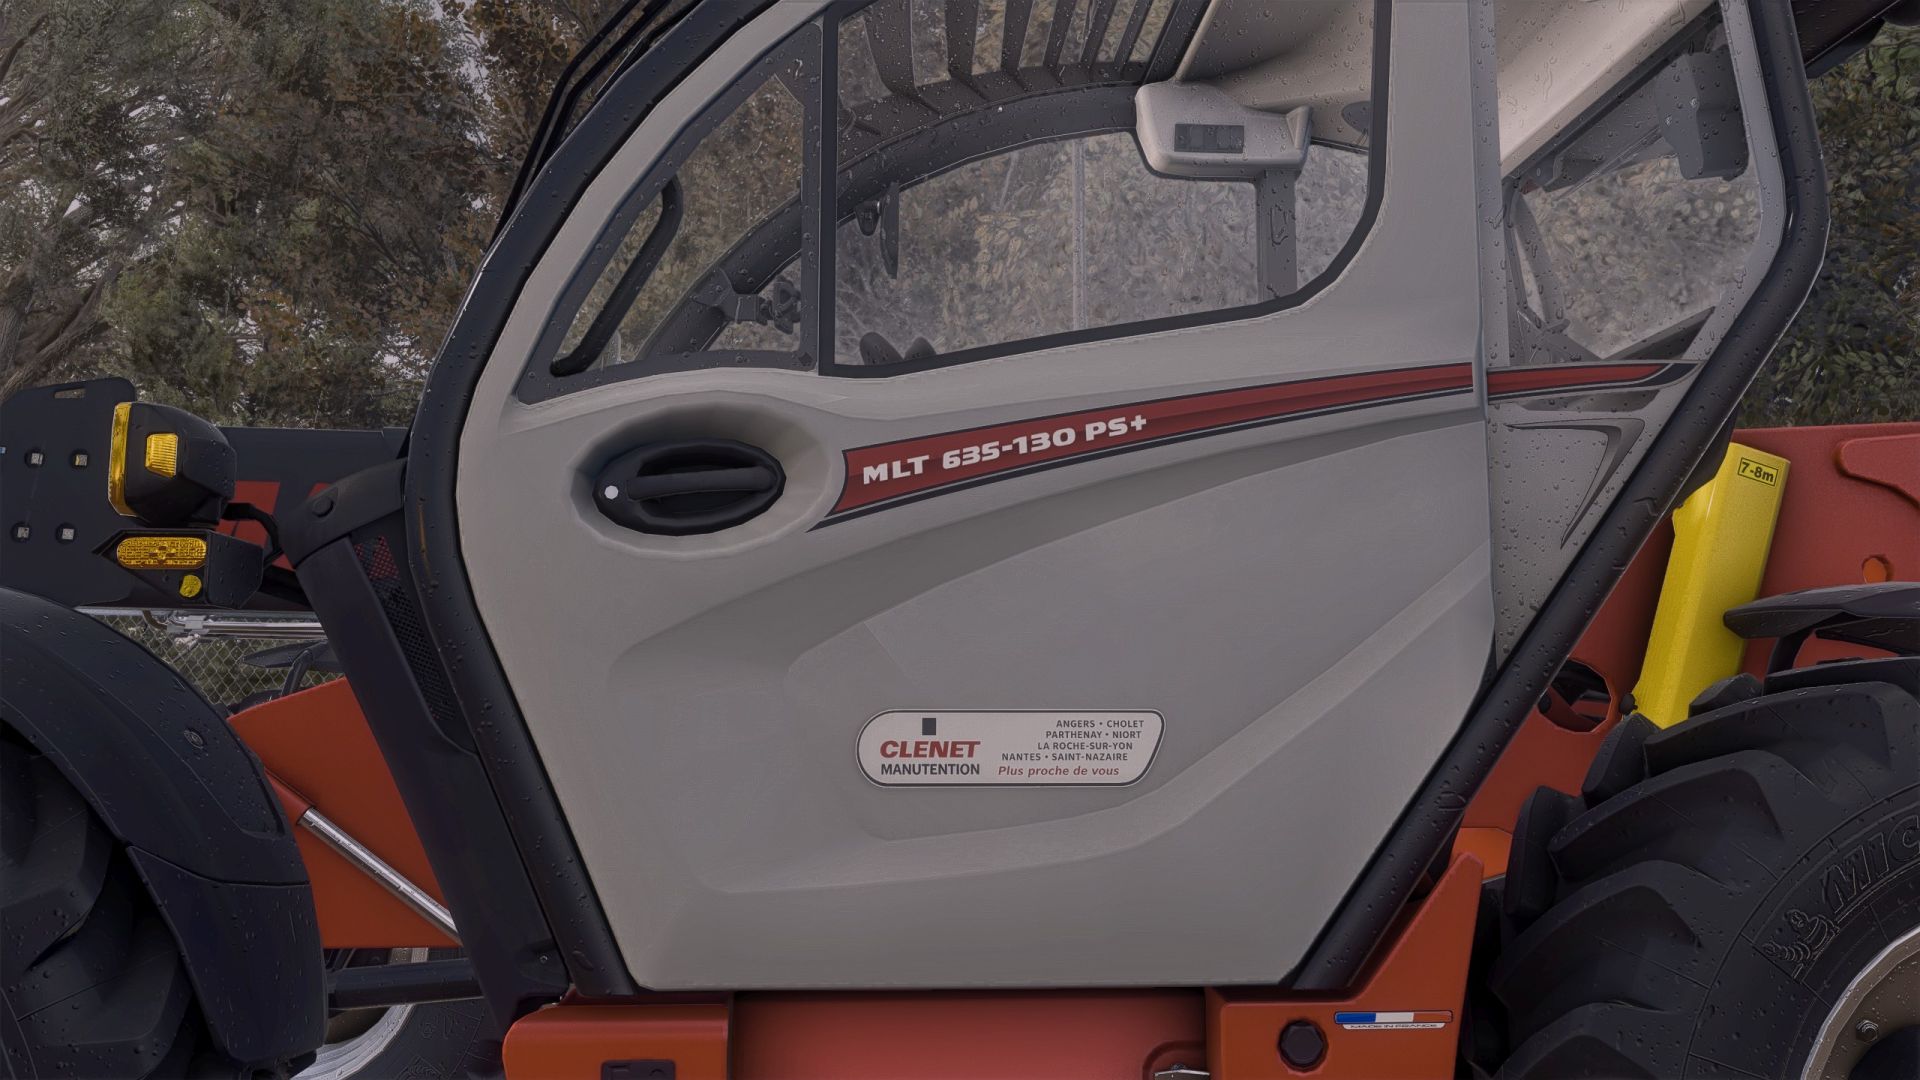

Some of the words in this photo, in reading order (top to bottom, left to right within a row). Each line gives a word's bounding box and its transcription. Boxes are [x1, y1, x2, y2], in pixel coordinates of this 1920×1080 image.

[863, 455, 930, 485] MLT
[942, 427, 1076, 470] 635-130
[1085, 414, 1147, 441] PS+
[1741, 461, 1774, 482] 7-8m
[1056, 720, 1095, 728] ANGERS
[1106, 720, 1144, 728] CHOLET
[1046, 731, 1102, 739] PARTHENAY
[1112, 731, 1142, 739] NIORT
[879, 740, 981, 758] CLENET
[1037, 742, 1050, 750] LA
[1053, 742, 1133, 750] ROCHE-SUR-YON
[1001, 753, 1041, 761] NANTES
[1051, 753, 1128, 761] SAINT-NAZAIRE
[880, 763, 980, 775] MANUTENTION
[998, 766, 1024, 776] Plus
[1028, 766, 1069, 778] proche
[1073, 766, 1088, 776] de
[1092, 767, 1119, 776] vous
